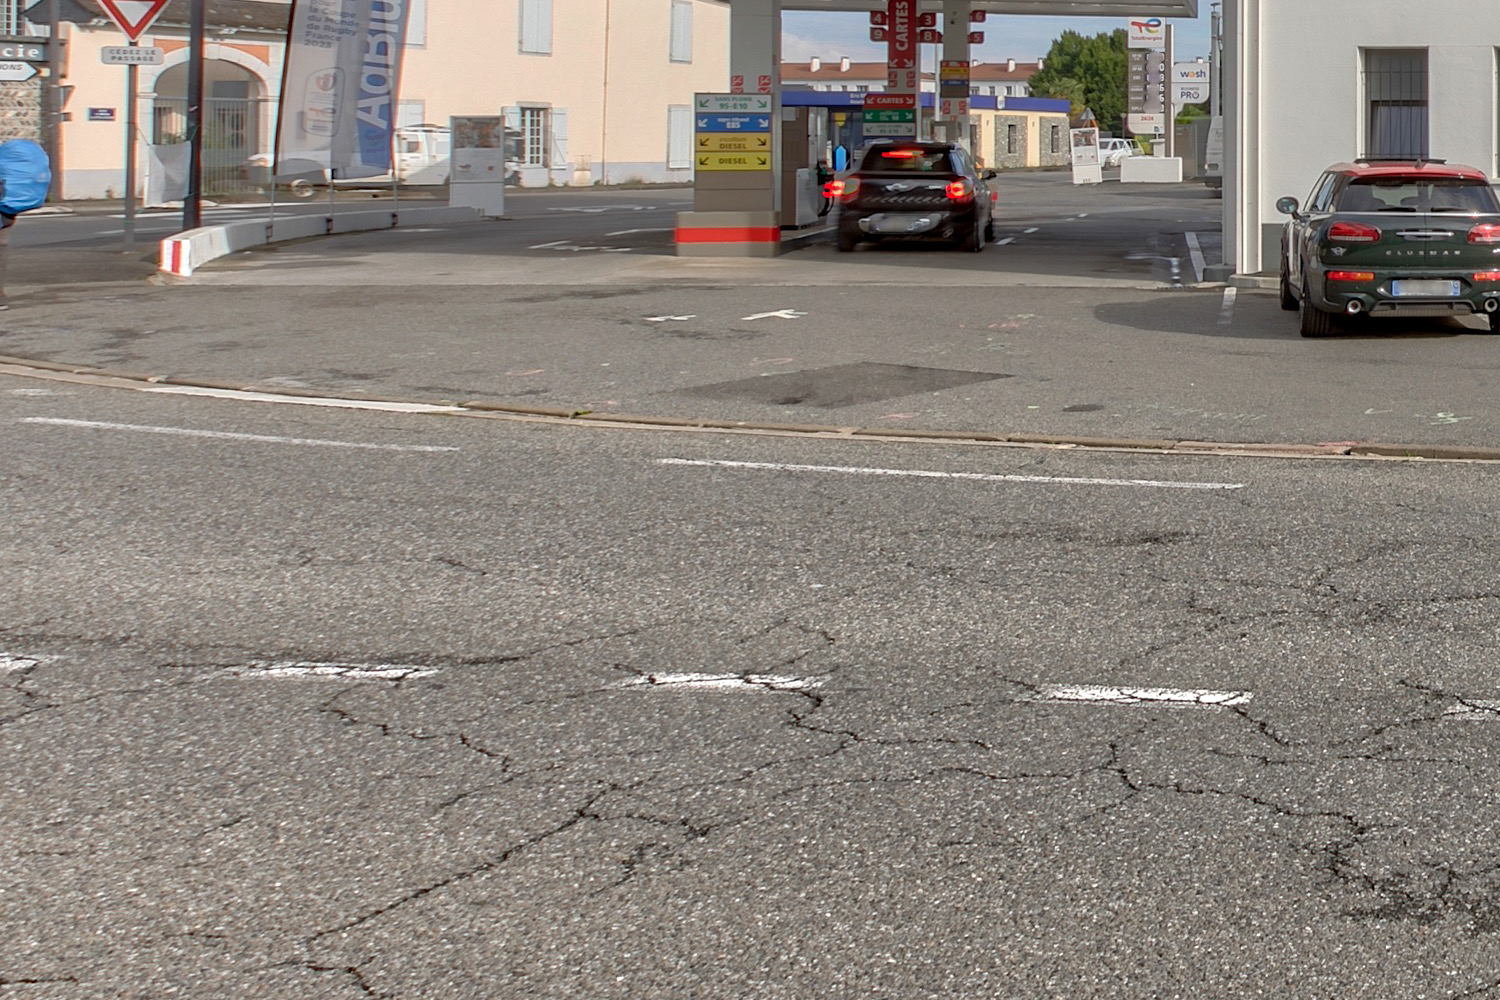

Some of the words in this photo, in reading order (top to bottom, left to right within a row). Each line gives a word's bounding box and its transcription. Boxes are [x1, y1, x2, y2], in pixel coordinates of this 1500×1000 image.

[321, 7, 357, 19] Coupe
[873, 13, 882, 24] 4
[975, 11, 983, 21] 6
[307, 14, 322, 22] du
[325, 16, 361, 28] Monde
[924, 15, 932, 25] 3
[306, 23, 321, 31] de
[323, 24, 358, 37] Rugby
[896, 1, 909, 51] CARTES
[305, 30, 342, 42] France
[873, 29, 882, 40] 9
[924, 31, 932, 41] 8
[973, 32, 980, 42] 5
[303, 38, 333, 49] 2023
[1180, 69, 1206, 78] wash
[1180, 91, 1200, 99] PRO
[718, 157, 748, 165] DIESEL
